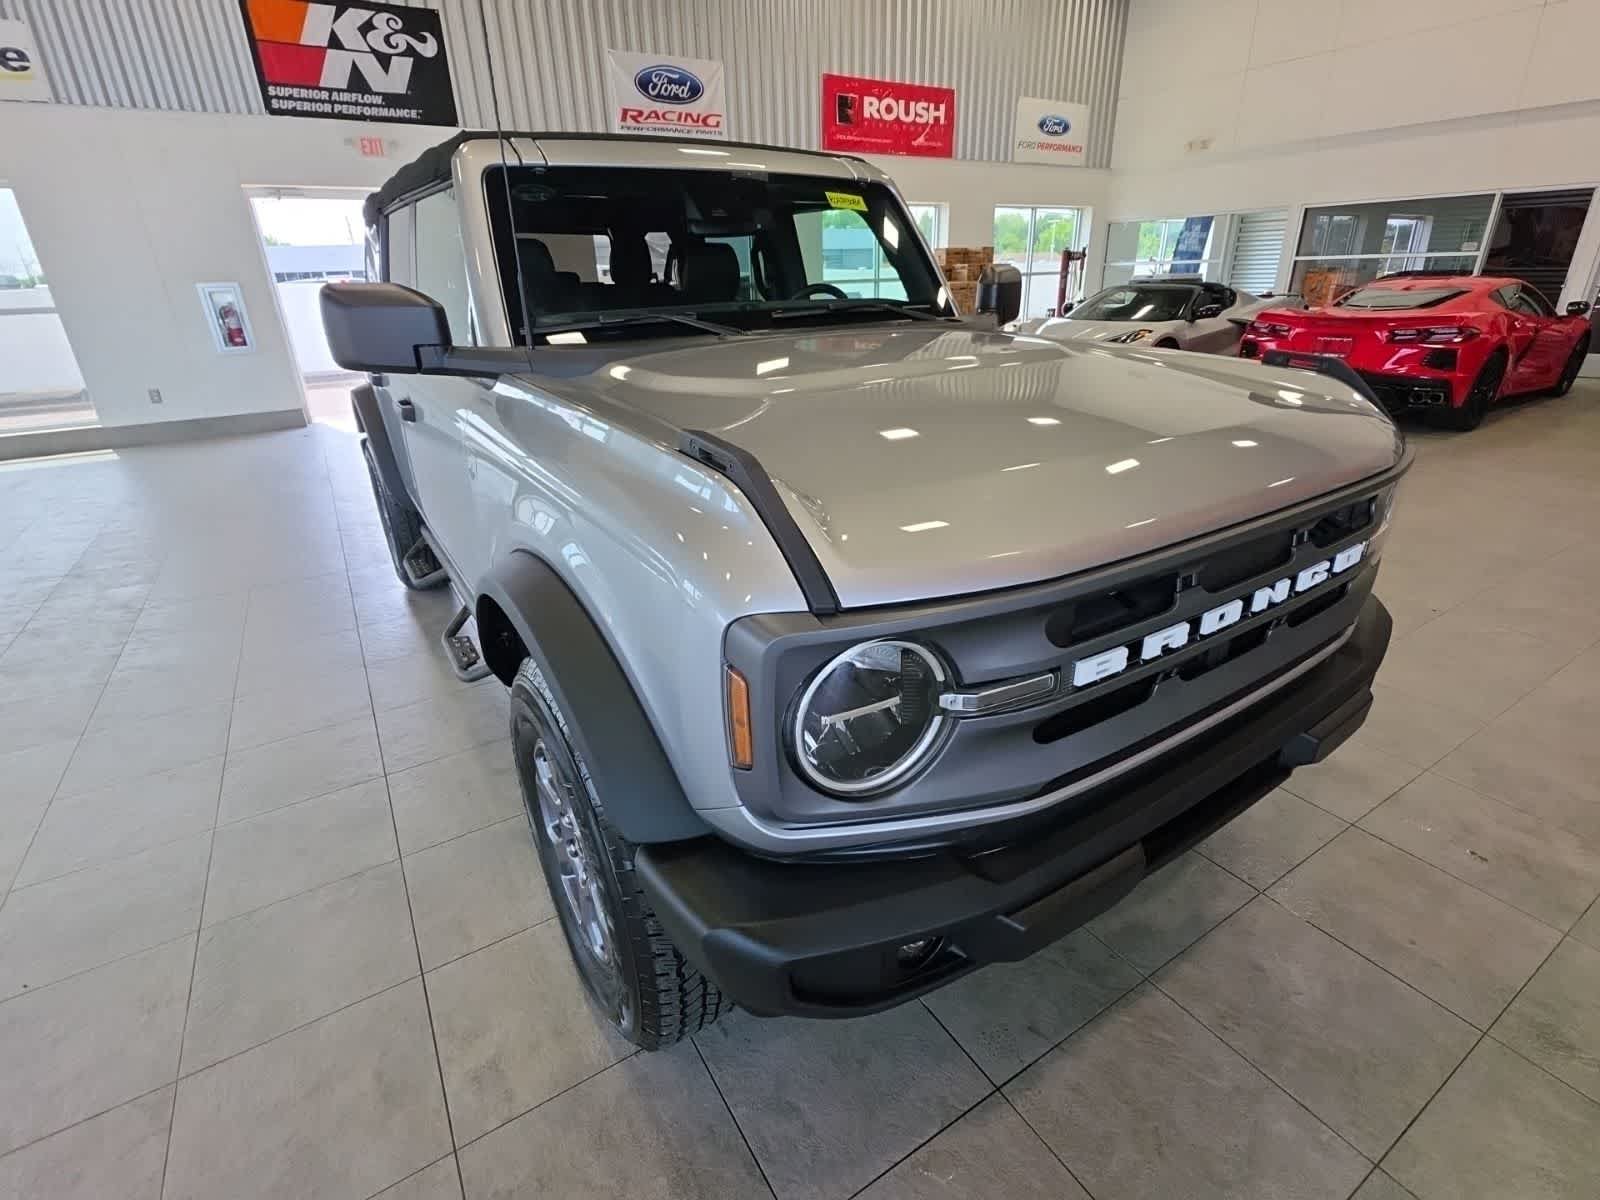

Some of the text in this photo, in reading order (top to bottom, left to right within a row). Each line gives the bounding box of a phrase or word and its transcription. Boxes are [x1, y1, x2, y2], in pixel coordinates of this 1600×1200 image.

[268, 86, 385, 106] SUPERIOR AIRFLOW.
[648, 70, 691, 98] Ford
[271, 98, 332, 113] SUPERIOR
[620, 107, 722, 129] RACING
[863, 95, 946, 125] ROUSH
[1072, 541, 1368, 688] BRONCO
